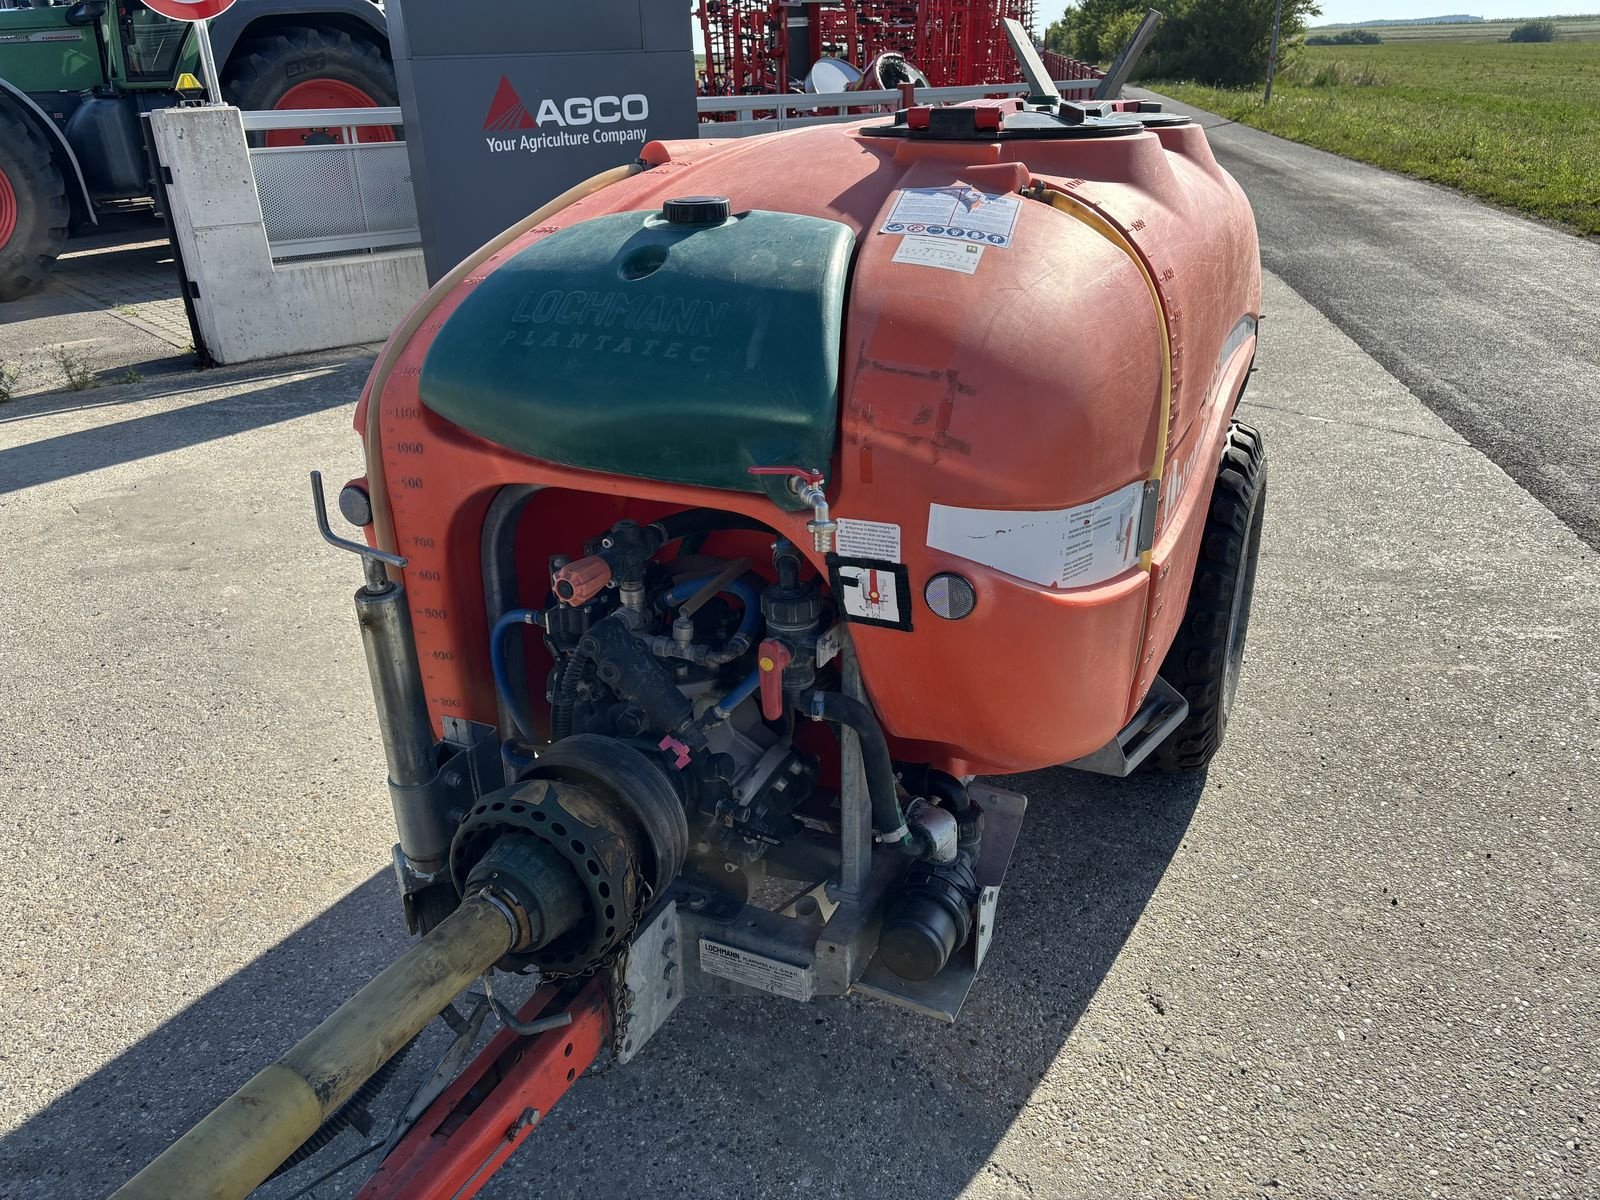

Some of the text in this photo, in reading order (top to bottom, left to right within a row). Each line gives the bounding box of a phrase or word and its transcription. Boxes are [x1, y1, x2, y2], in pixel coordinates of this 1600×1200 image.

[535, 93, 649, 127] AGCO
[486, 127, 647, 153] Your Agriculture Company
[511, 290, 730, 337] LOCHMANN
[501, 329, 712, 363] PLANTATEC
[394, 407, 421, 418] 1100
[397, 442, 424, 454] 1000
[412, 536, 435, 548] 700
[418, 570, 441, 582] 600
[432, 650, 454, 661] 400
[704, 943, 740, 959] LOCHMANN
